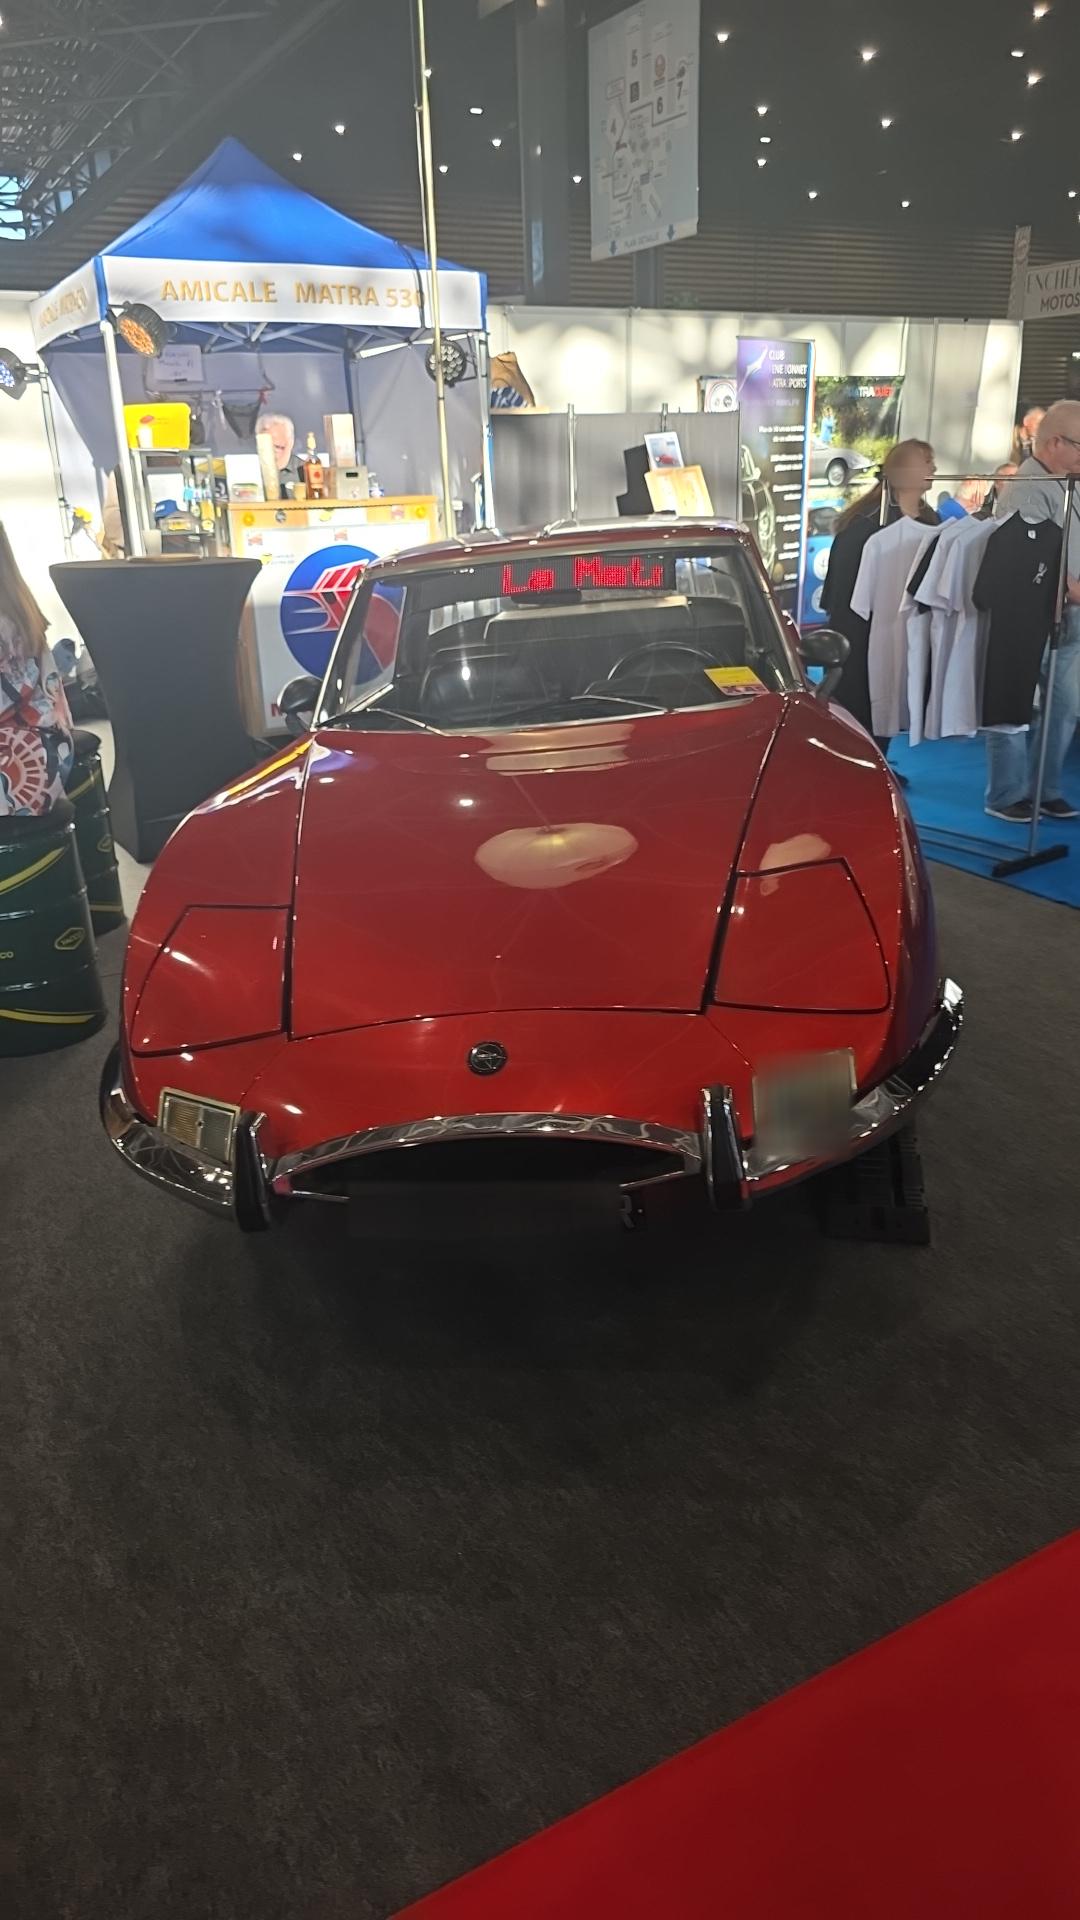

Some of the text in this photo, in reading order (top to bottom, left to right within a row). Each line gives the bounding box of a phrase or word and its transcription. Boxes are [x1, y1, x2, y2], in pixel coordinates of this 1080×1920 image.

[677, 81, 683, 100] 7
[656, 95, 664, 114] 6
[160, 279, 278, 303] AMICALE
[294, 281, 380, 306] MATRA
[1040, 292, 1080, 312] MOTOS
[768, 350, 785, 361] CLUB
[502, 564, 554, 594] La
